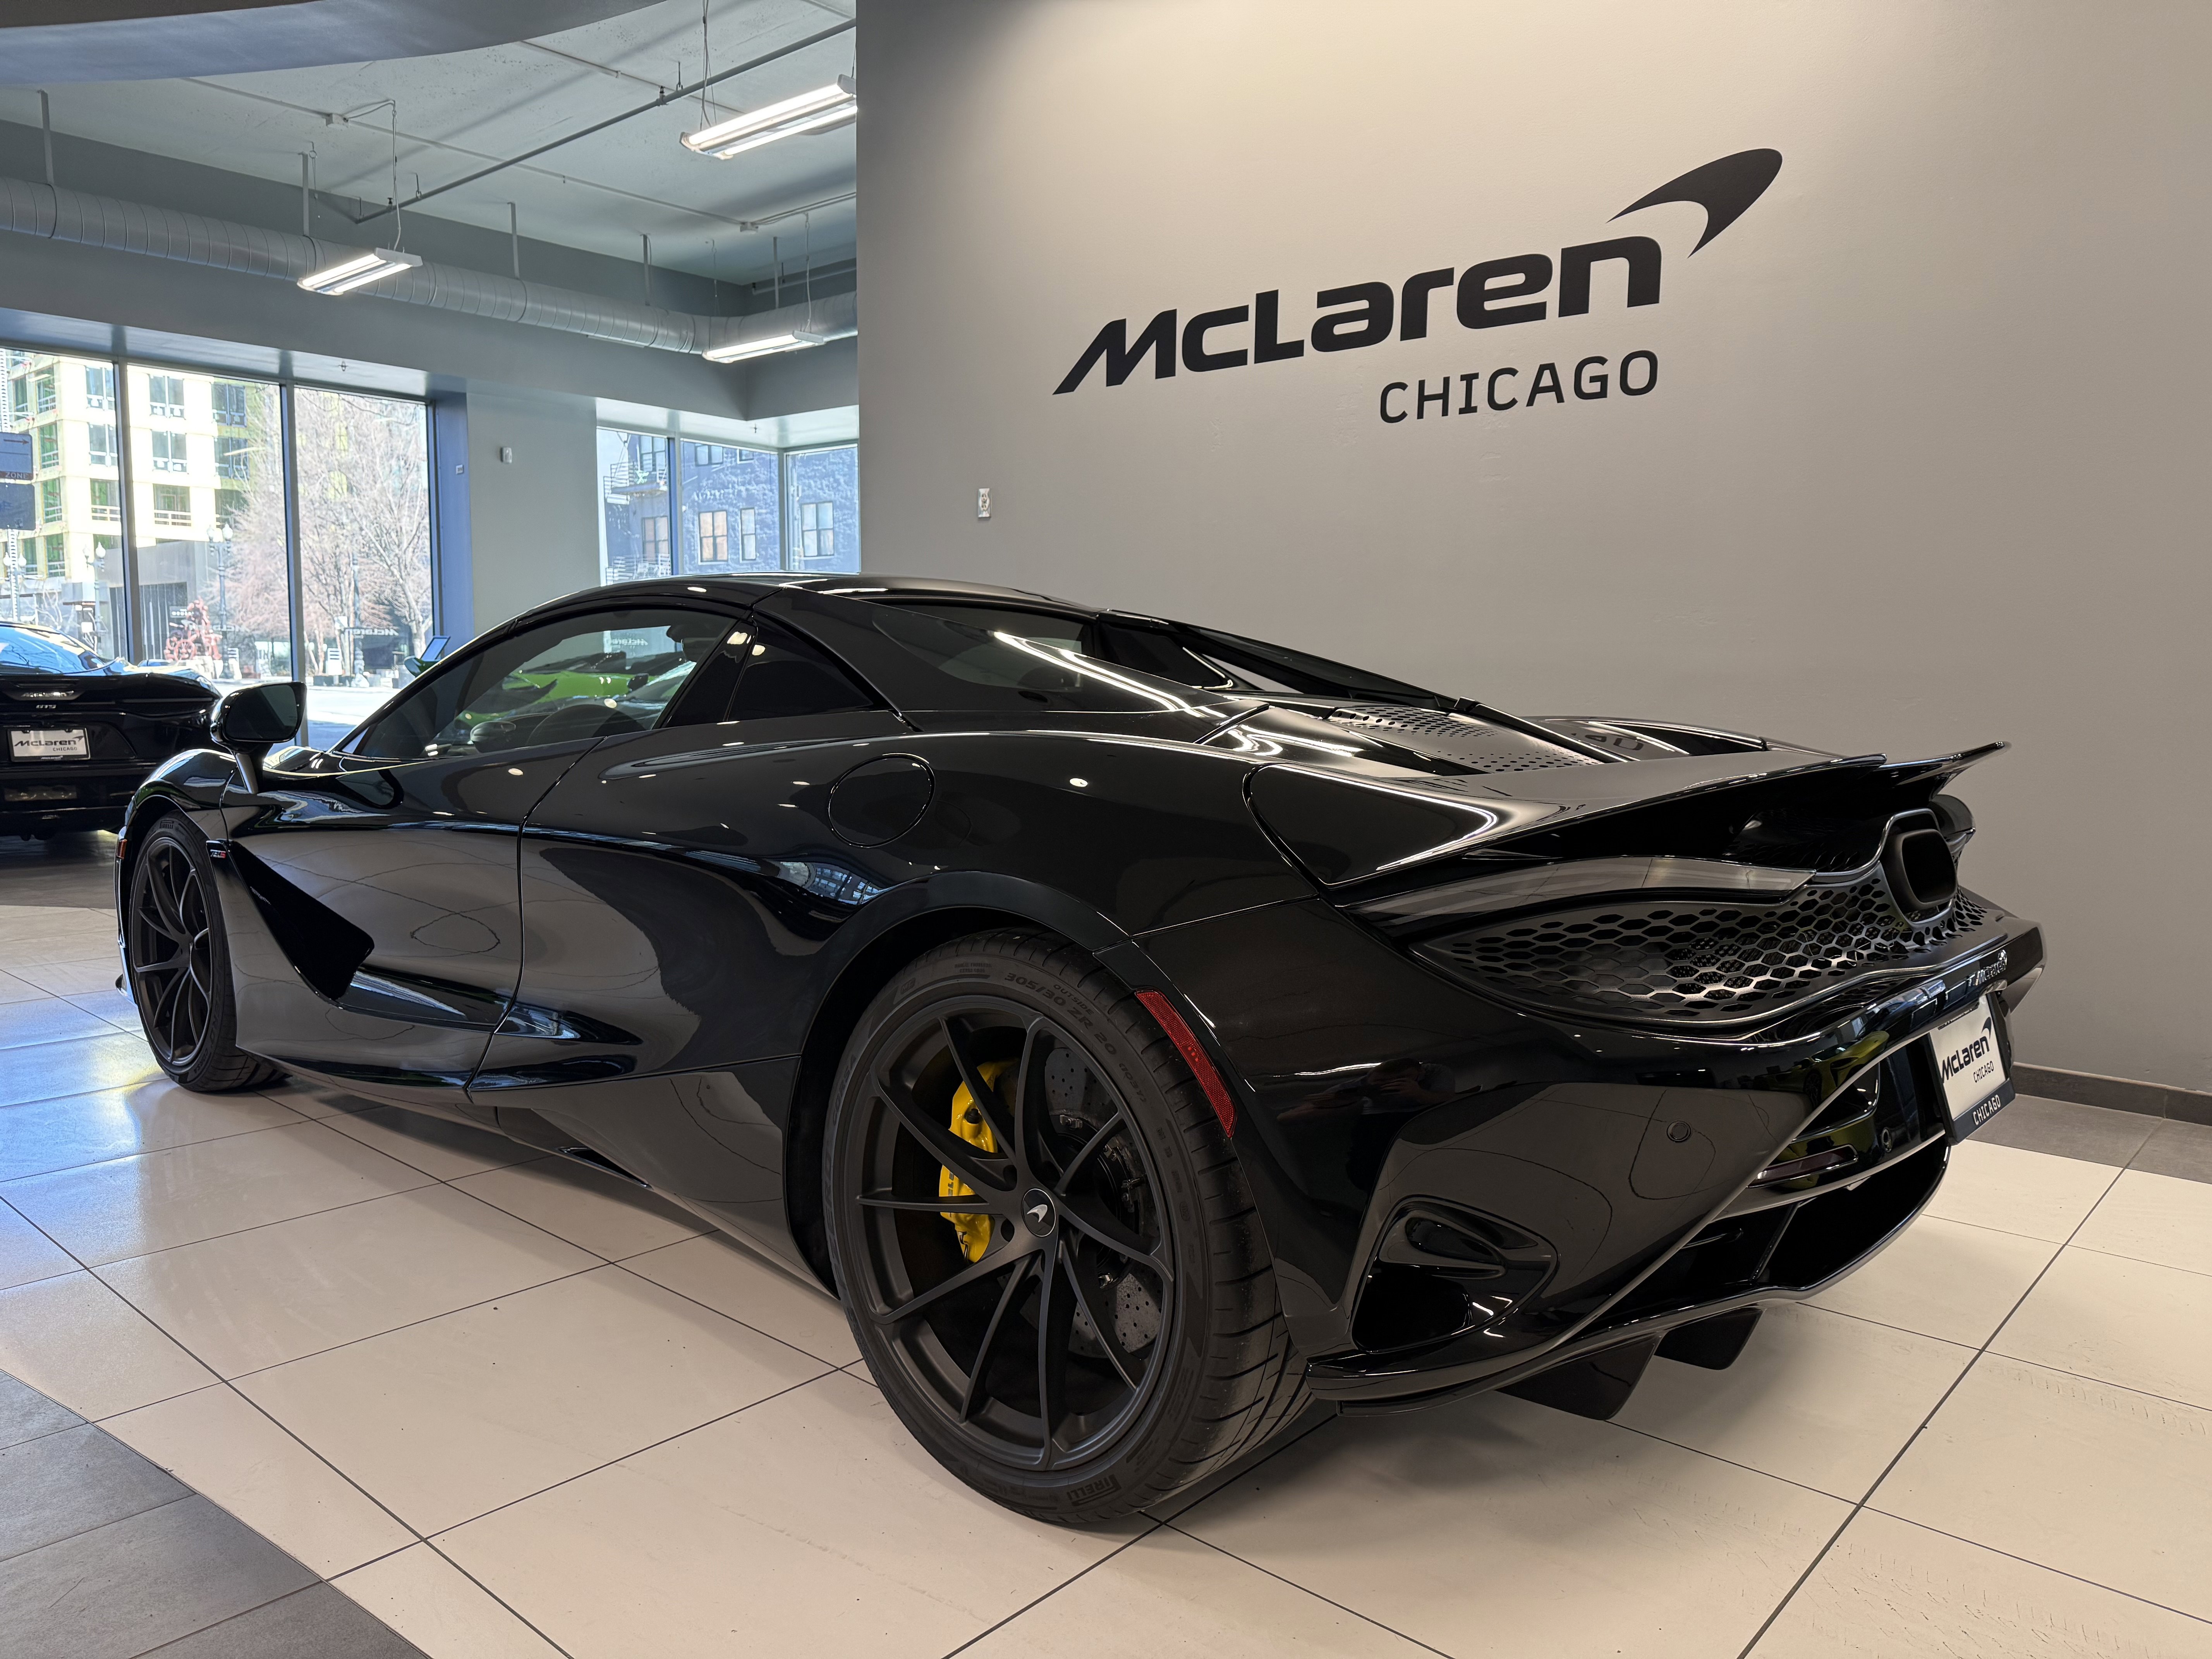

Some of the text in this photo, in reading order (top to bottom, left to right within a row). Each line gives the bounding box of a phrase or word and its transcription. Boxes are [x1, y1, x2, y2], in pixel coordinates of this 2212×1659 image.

[1052, 236, 1662, 395] McLaren
[1380, 350, 1658, 423] CHICAGO
[1005, 972, 1066, 1006] 305/30
[1067, 1006, 1094, 1030] ZR
[1094, 1032, 1117, 1055] 20
[1053, 984, 1095, 1016] OUTSIDE
[1940, 1036, 1990, 1084] McLaren
[1973, 1060, 1994, 1083] CHICAGO
[1973, 1094, 2001, 1125] CHICAGO
[1066, 1474, 1121, 1507] PIRELLI
